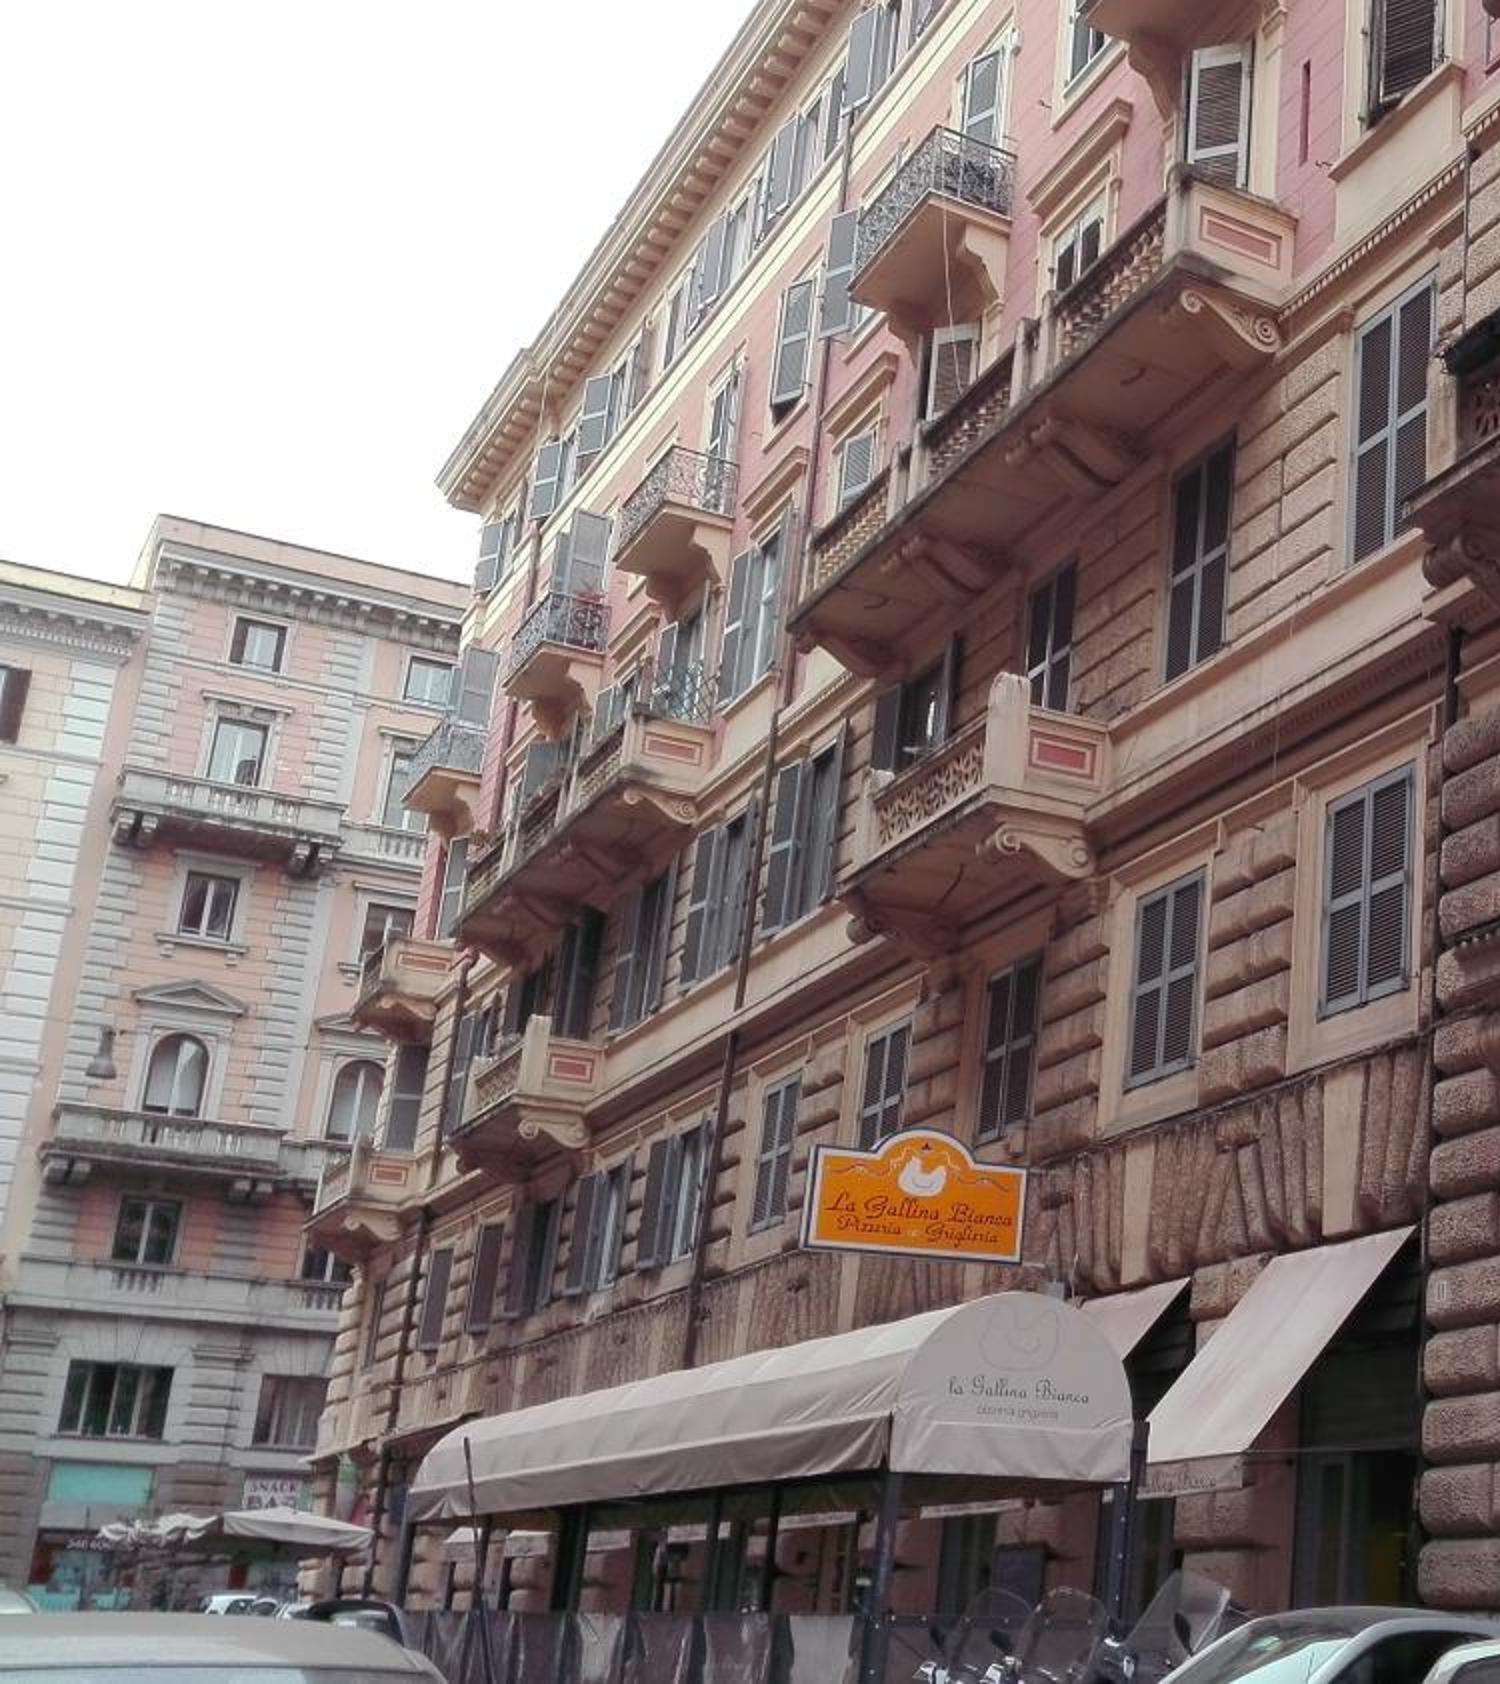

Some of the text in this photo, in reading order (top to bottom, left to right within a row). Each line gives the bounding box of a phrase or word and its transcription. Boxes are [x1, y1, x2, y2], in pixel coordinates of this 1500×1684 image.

[826, 1190, 1012, 1227] La Gallina Bianca
[971, 1375, 1028, 1400] Gallina
[1036, 1378, 1089, 1404] Bianca
